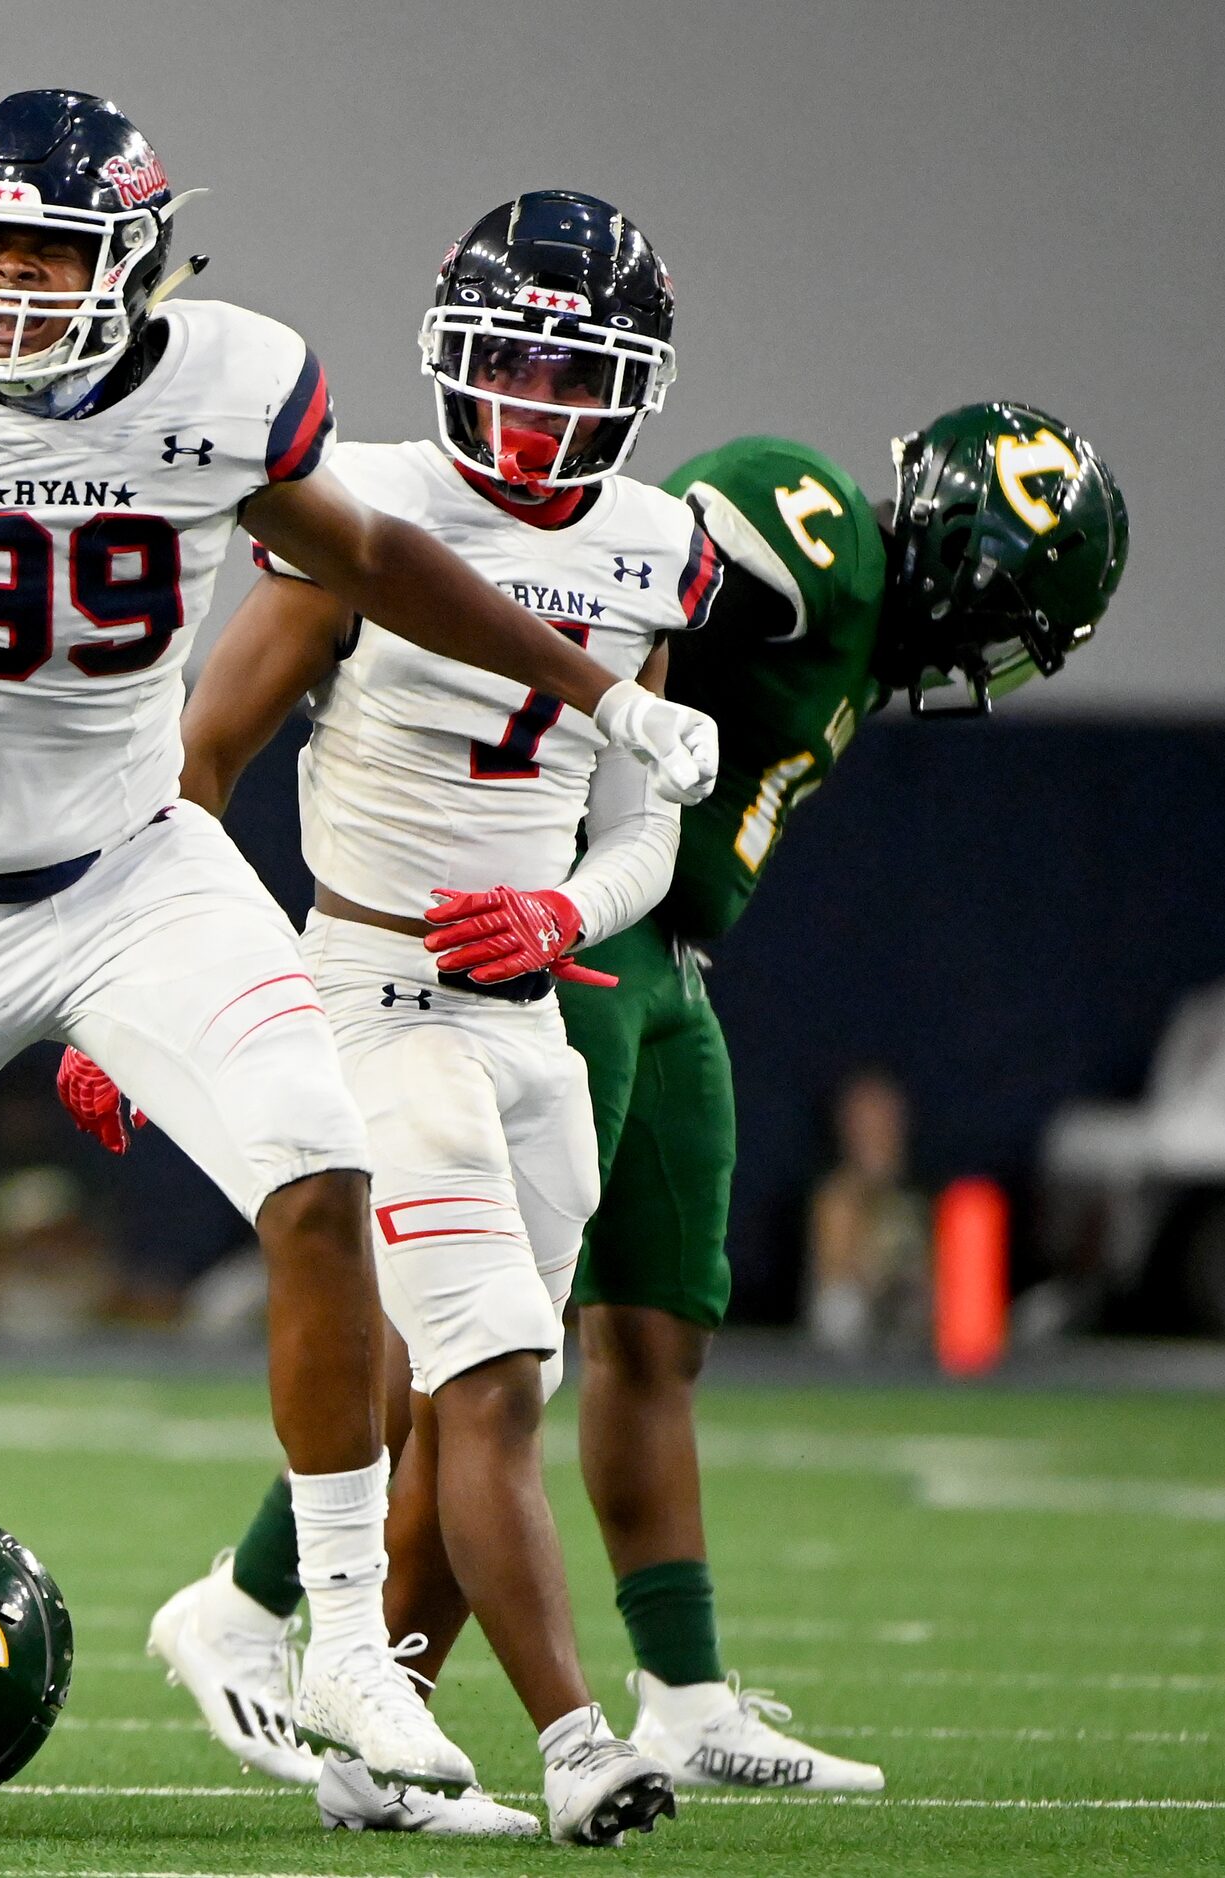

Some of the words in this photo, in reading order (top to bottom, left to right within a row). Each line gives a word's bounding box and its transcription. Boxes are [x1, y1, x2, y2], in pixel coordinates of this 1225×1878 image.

[14, 480, 110, 508] RYAN
[995, 428, 1080, 535] L
[775, 475, 844, 570] L
[512, 583, 585, 617] RYAN
[469, 619, 591, 781] 7
[683, 1745, 813, 1786] ADIZERO
